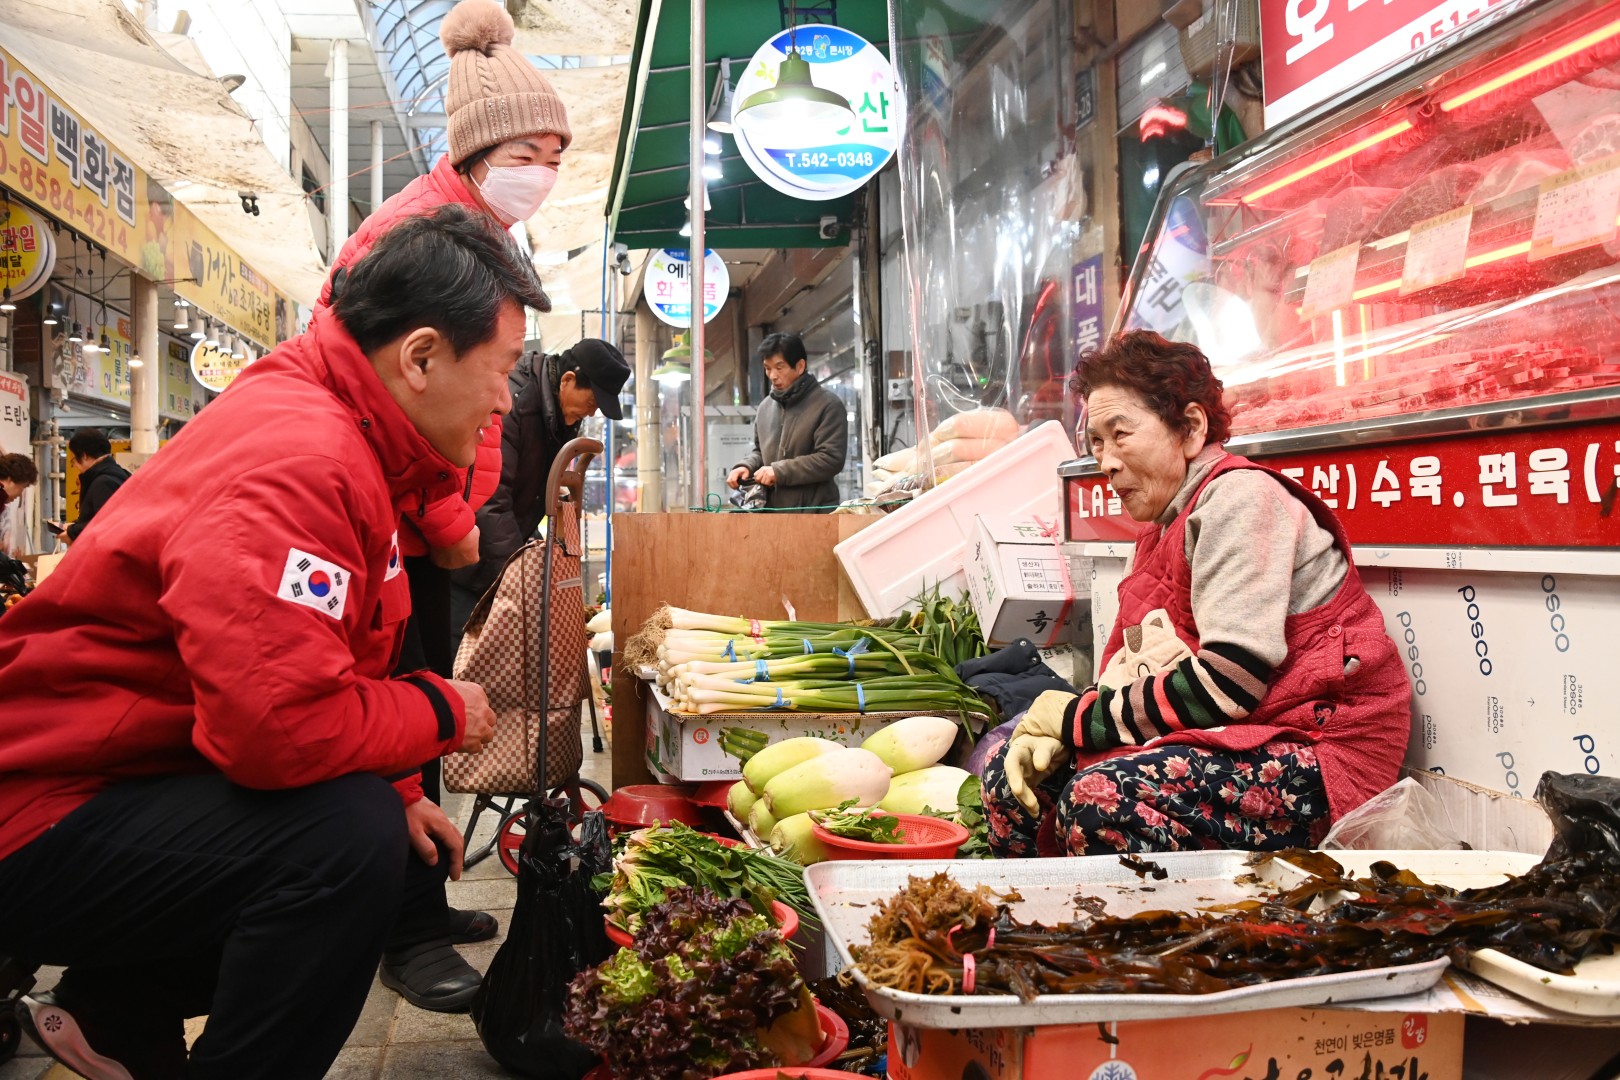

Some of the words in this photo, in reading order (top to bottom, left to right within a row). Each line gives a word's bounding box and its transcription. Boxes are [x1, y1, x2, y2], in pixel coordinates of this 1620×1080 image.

[785, 151, 873, 168] T.542-0348
[1457, 585, 1493, 677] posco
[1396, 611, 1427, 696] posco
[1568, 674, 1577, 715] posco
[1491, 696, 1499, 734] posco
[1314, 1036, 1348, 1056] 천연이
[1352, 1028, 1396, 1049] 빚은명품
